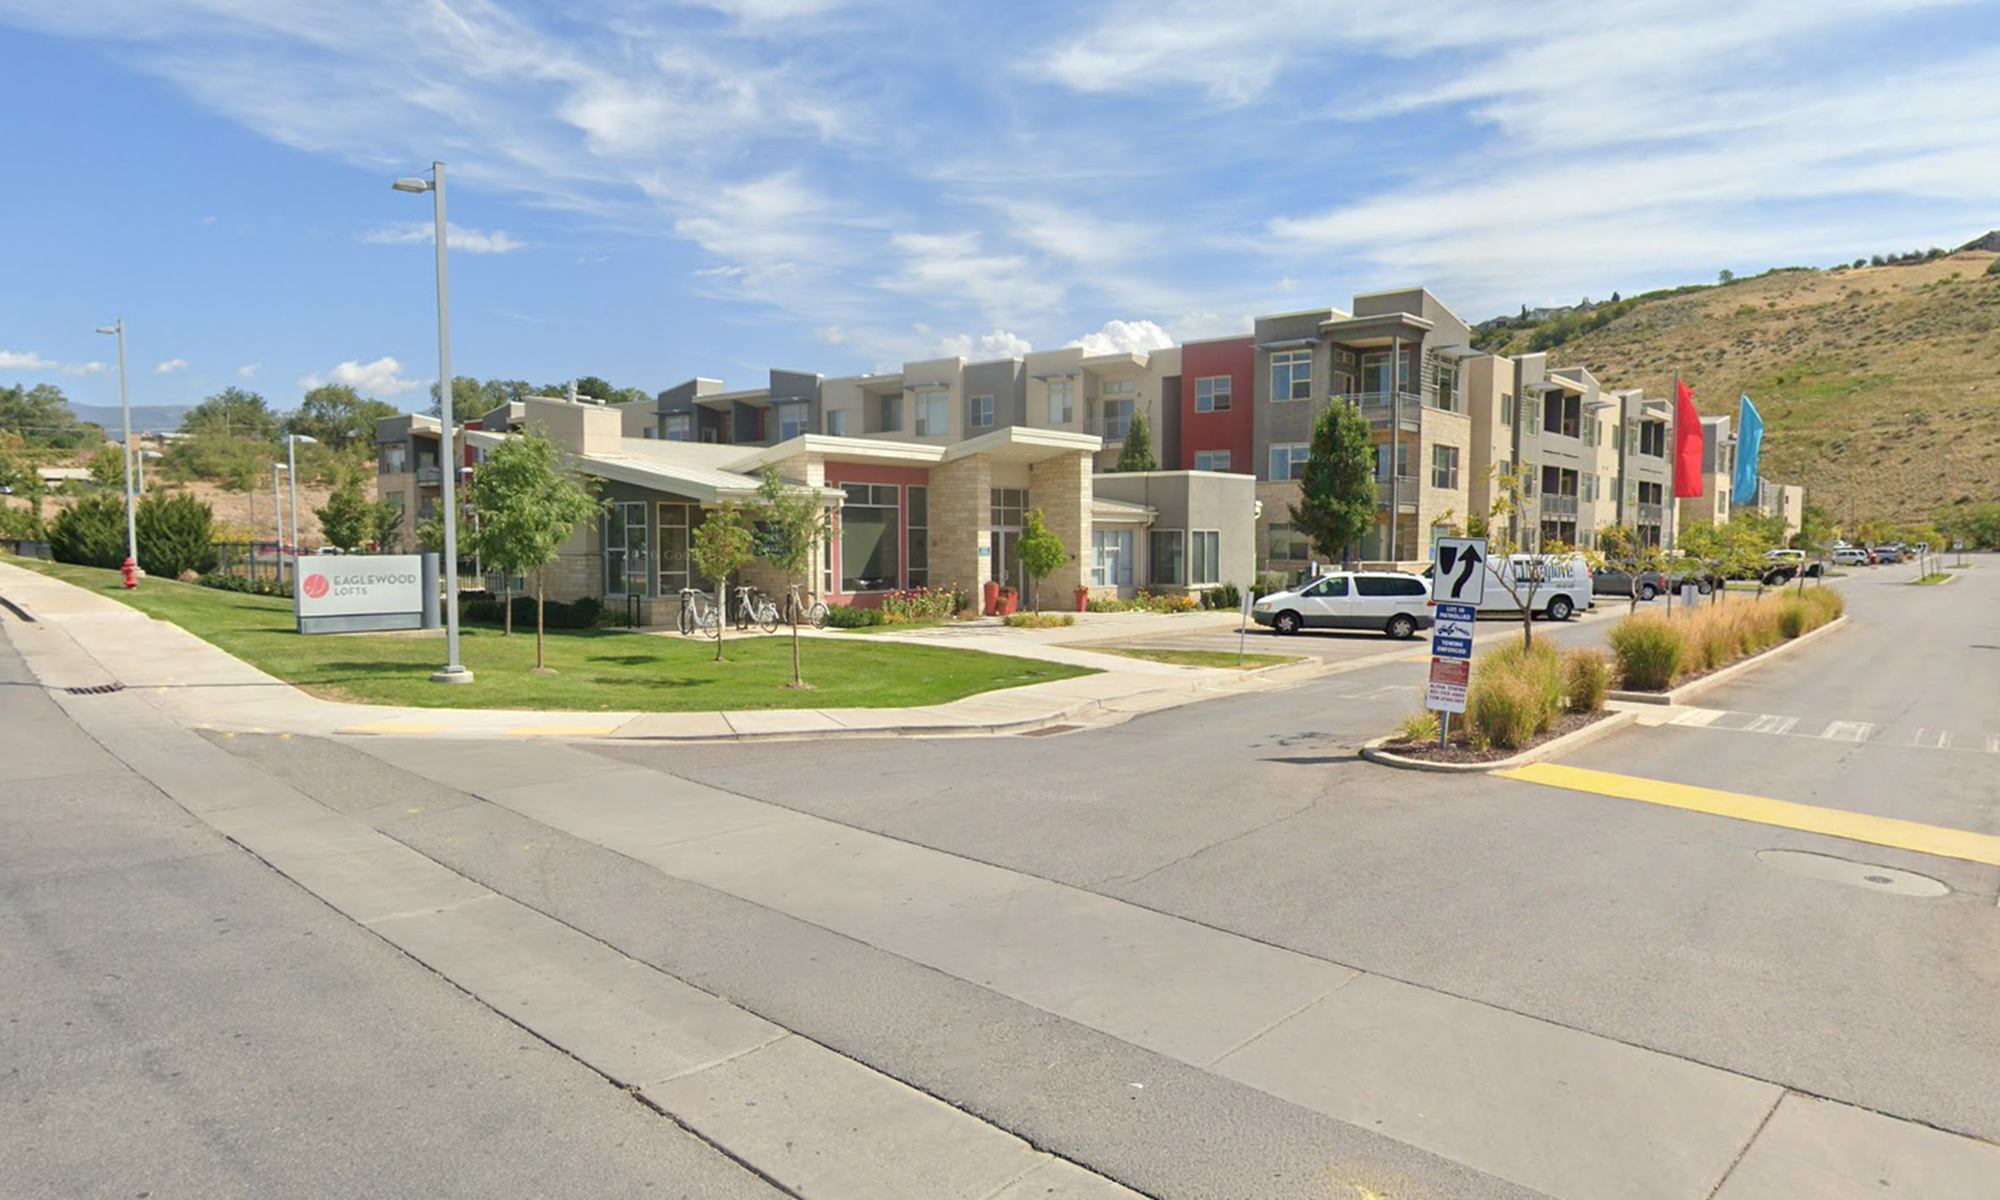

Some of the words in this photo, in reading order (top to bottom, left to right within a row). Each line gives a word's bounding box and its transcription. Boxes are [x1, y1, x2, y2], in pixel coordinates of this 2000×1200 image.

[333, 574, 417, 586] EAGLEWOOD
[334, 587, 368, 596] LOFTS
[1439, 613, 1472, 621] PATROLLED
[1436, 646, 1467, 654] ENFORCED
